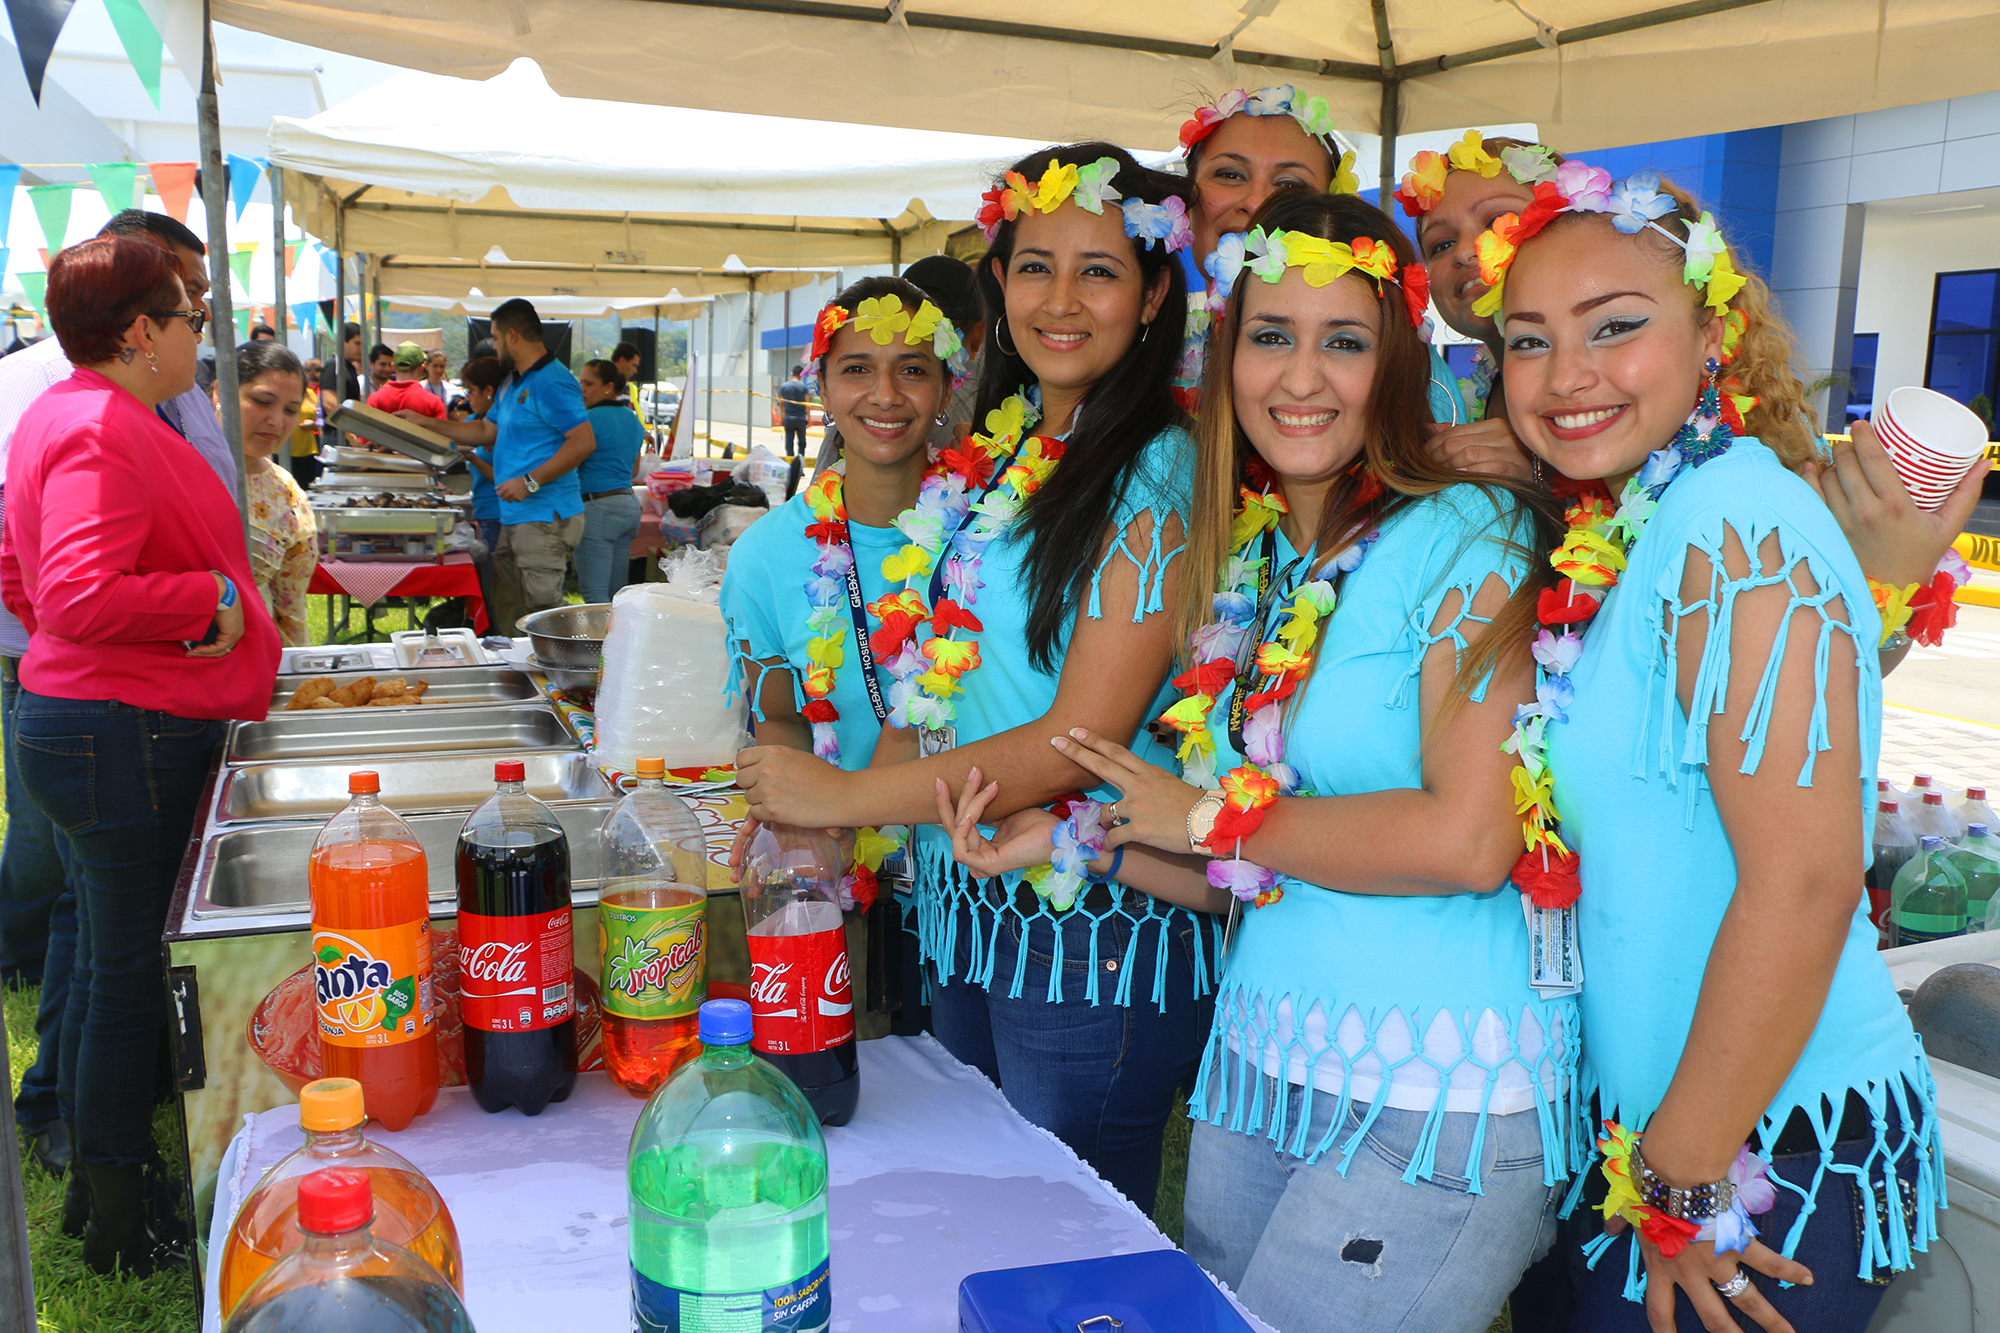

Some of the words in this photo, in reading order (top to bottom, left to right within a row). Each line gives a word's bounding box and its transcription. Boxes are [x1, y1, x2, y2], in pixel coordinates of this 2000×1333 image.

[856, 627, 872, 670] HOSIERY
[866, 676, 886, 719] GILDAN
[609, 911, 613, 919] 3
[613, 912, 637, 923] LITROS
[458, 941, 534, 983] a-Cola
[626, 918, 702, 996] Tropical
[313, 951, 390, 1006] anta
[750, 962, 795, 1004] ola
[386, 993, 408, 1010] SABOR
[393, 989, 409, 1002] RICO
[501, 1019, 507, 1029] 3
[508, 1020, 514, 1030] L
[377, 1033, 383, 1044] 3
[384, 1033, 390, 1043] L
[778, 1040, 783, 1051] 3
[785, 1041, 790, 1051] L
[773, 1292, 798, 1309] 100%
[797, 1279, 820, 1300] SABOR
[773, 1308, 789, 1322] SIN
